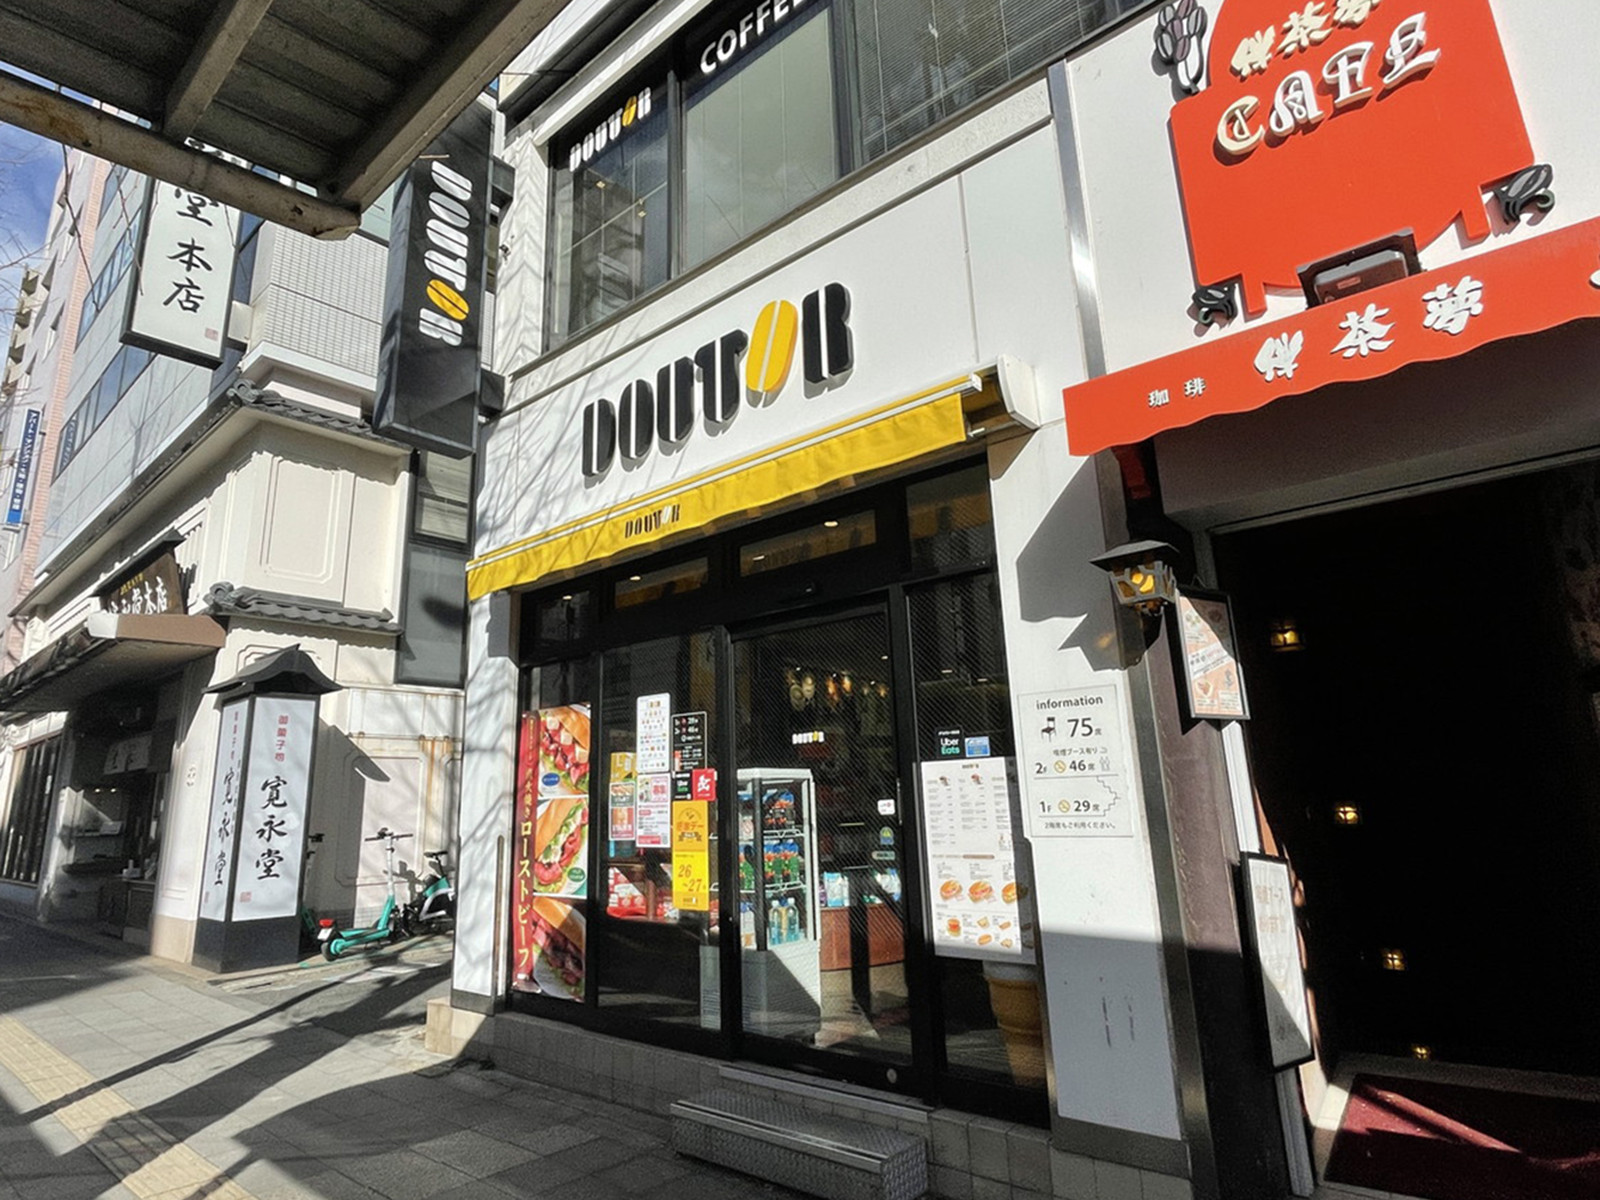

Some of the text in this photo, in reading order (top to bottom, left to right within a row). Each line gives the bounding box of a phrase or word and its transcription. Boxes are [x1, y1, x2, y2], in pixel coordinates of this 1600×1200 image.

[700, 0, 803, 74] COFFE
[1217, 12, 1441, 155] CAFE
[569, 86, 651, 172] DOUTOR
[419, 161, 473, 346] DOUTOR
[581, 282, 854, 480] DOUTOR
[1148, 378, 1206, 408] 珈琲
[625, 504, 680, 538] DOUTOR
[1036, 695, 1103, 710] information
[940, 738, 960, 747] Uber
[941, 746, 960, 755] Eats
[256, 775, 288, 880] 寛永堂
